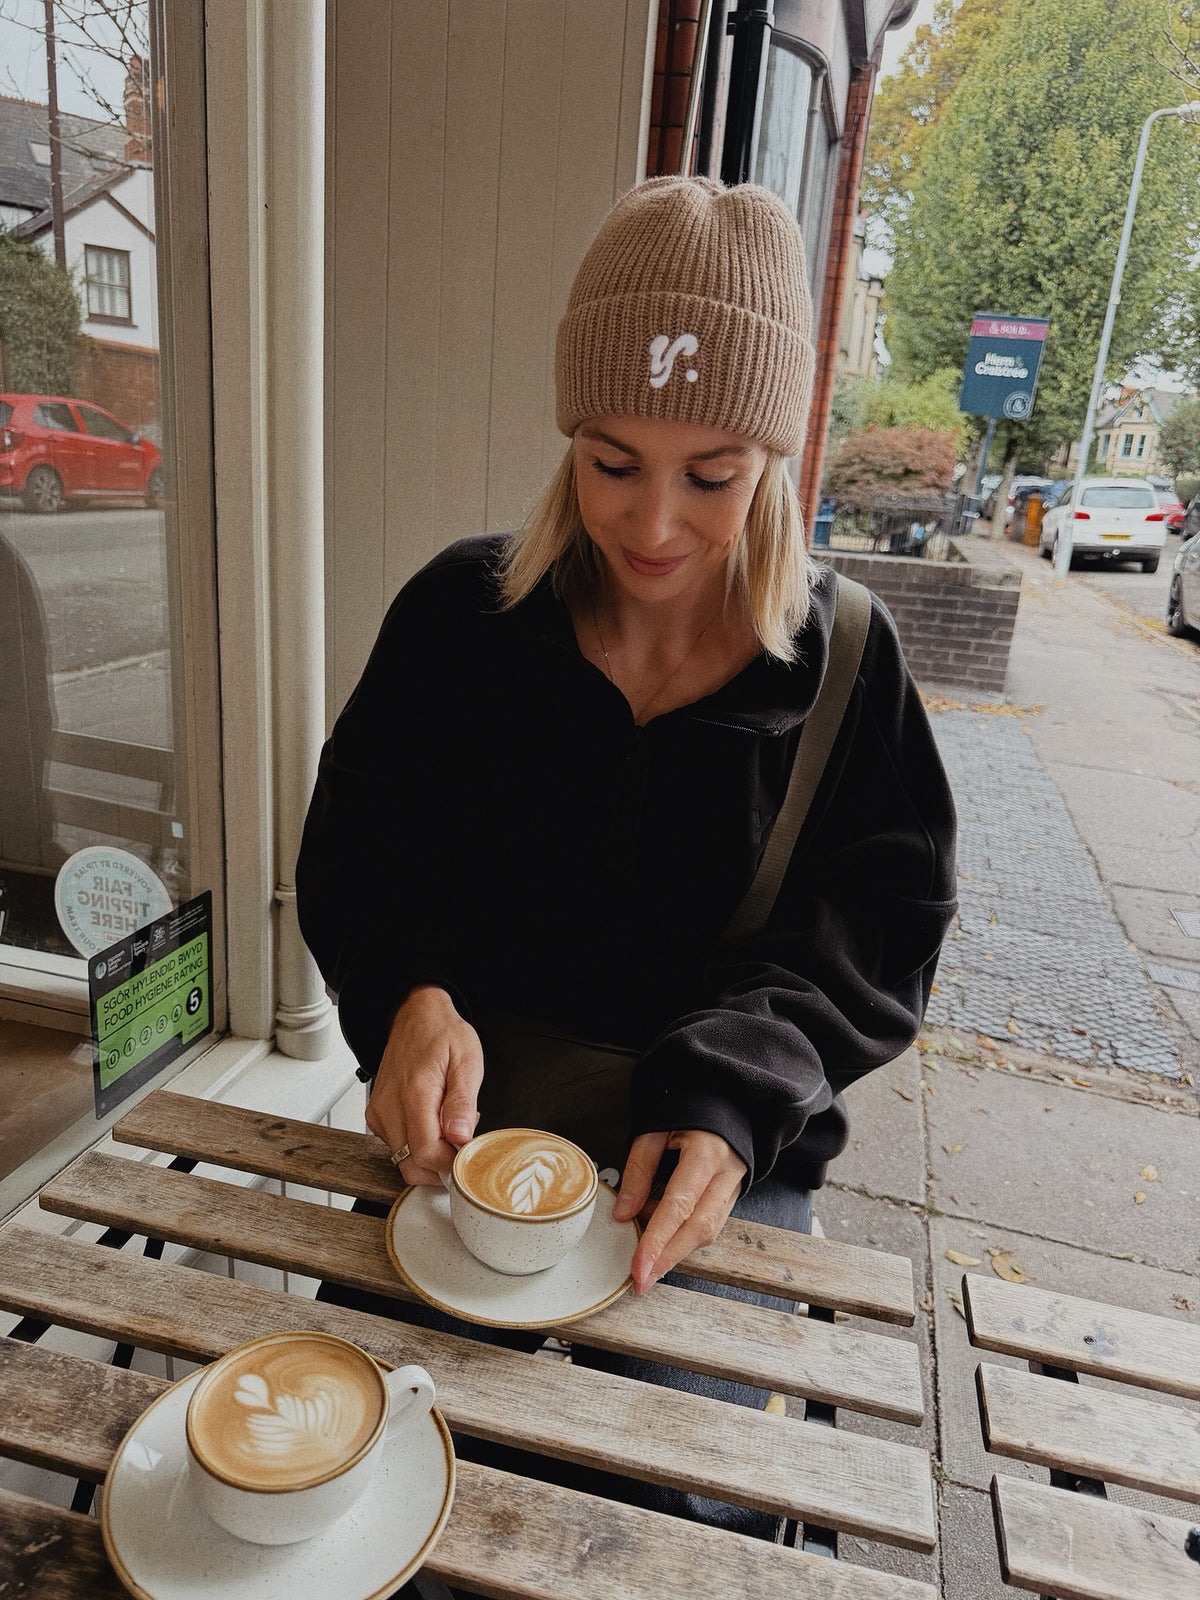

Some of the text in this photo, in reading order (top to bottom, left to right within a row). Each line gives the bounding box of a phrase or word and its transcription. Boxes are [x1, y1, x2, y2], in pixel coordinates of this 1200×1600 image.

[103, 989, 130, 1014] SGÔR
[132, 960, 175, 995] HYLENDID
[178, 942, 203, 966] BWYD
[105, 957, 203, 1030] FOOD HYGIENE RATING
[189, 990, 199, 1012] 5
